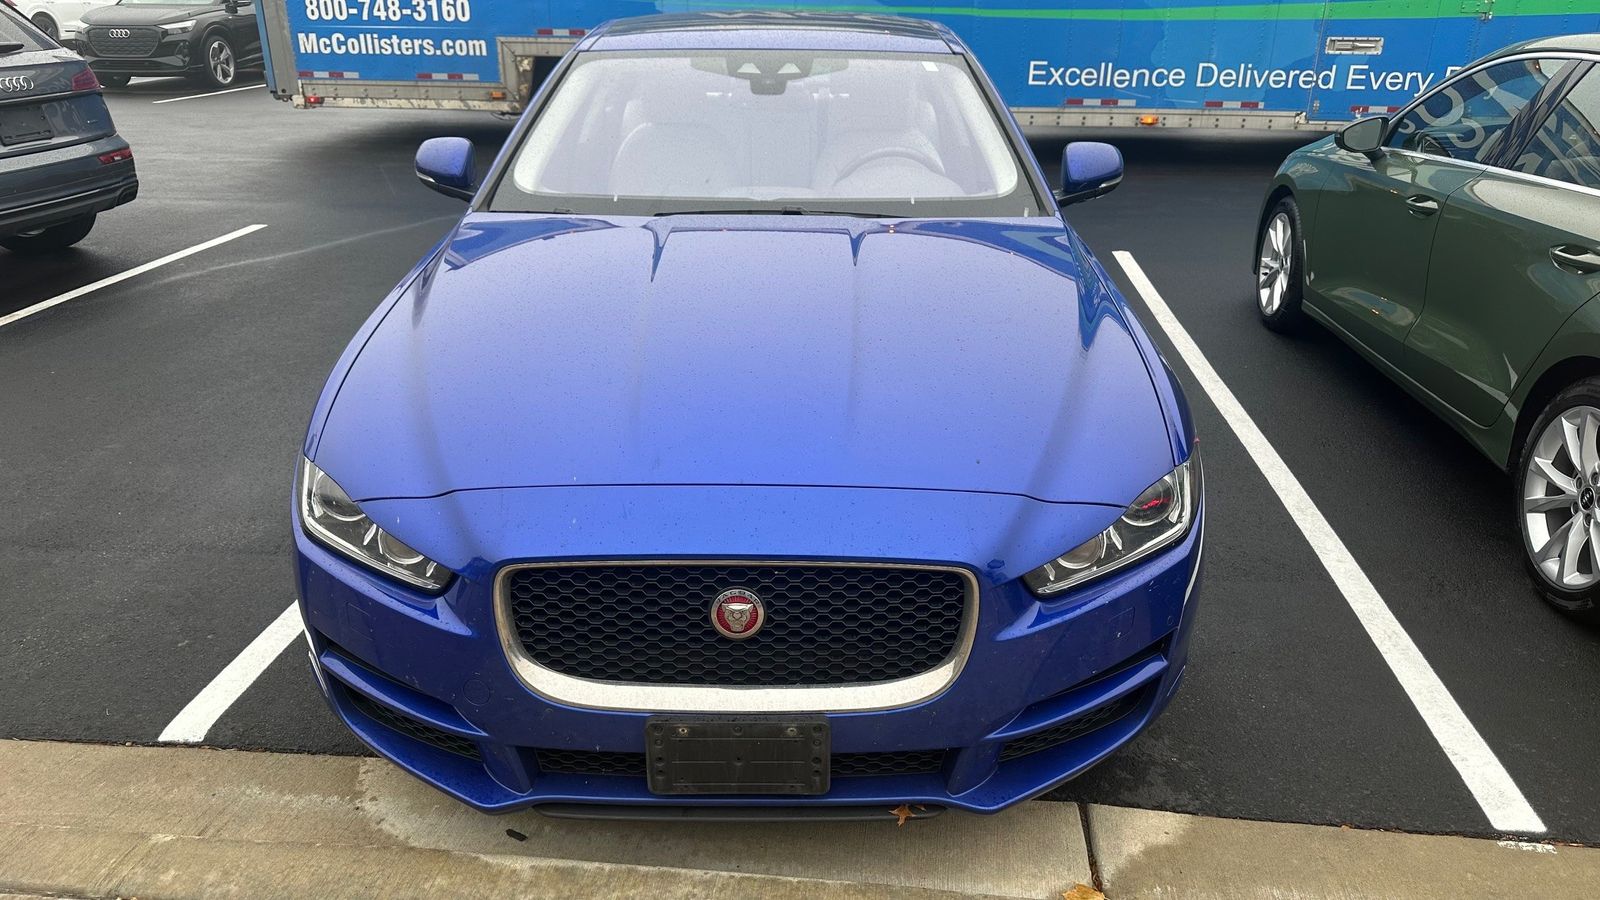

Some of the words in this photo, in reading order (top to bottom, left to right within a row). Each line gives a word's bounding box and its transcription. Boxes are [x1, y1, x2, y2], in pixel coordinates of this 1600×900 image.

[305, 0, 471, 22] 800-748-3160
[297, 32, 487, 56] McCollisters.com
[1028, 61, 1186, 88] Excellence
[1196, 62, 1337, 89] Delivered
[1346, 65, 1434, 97] Every
